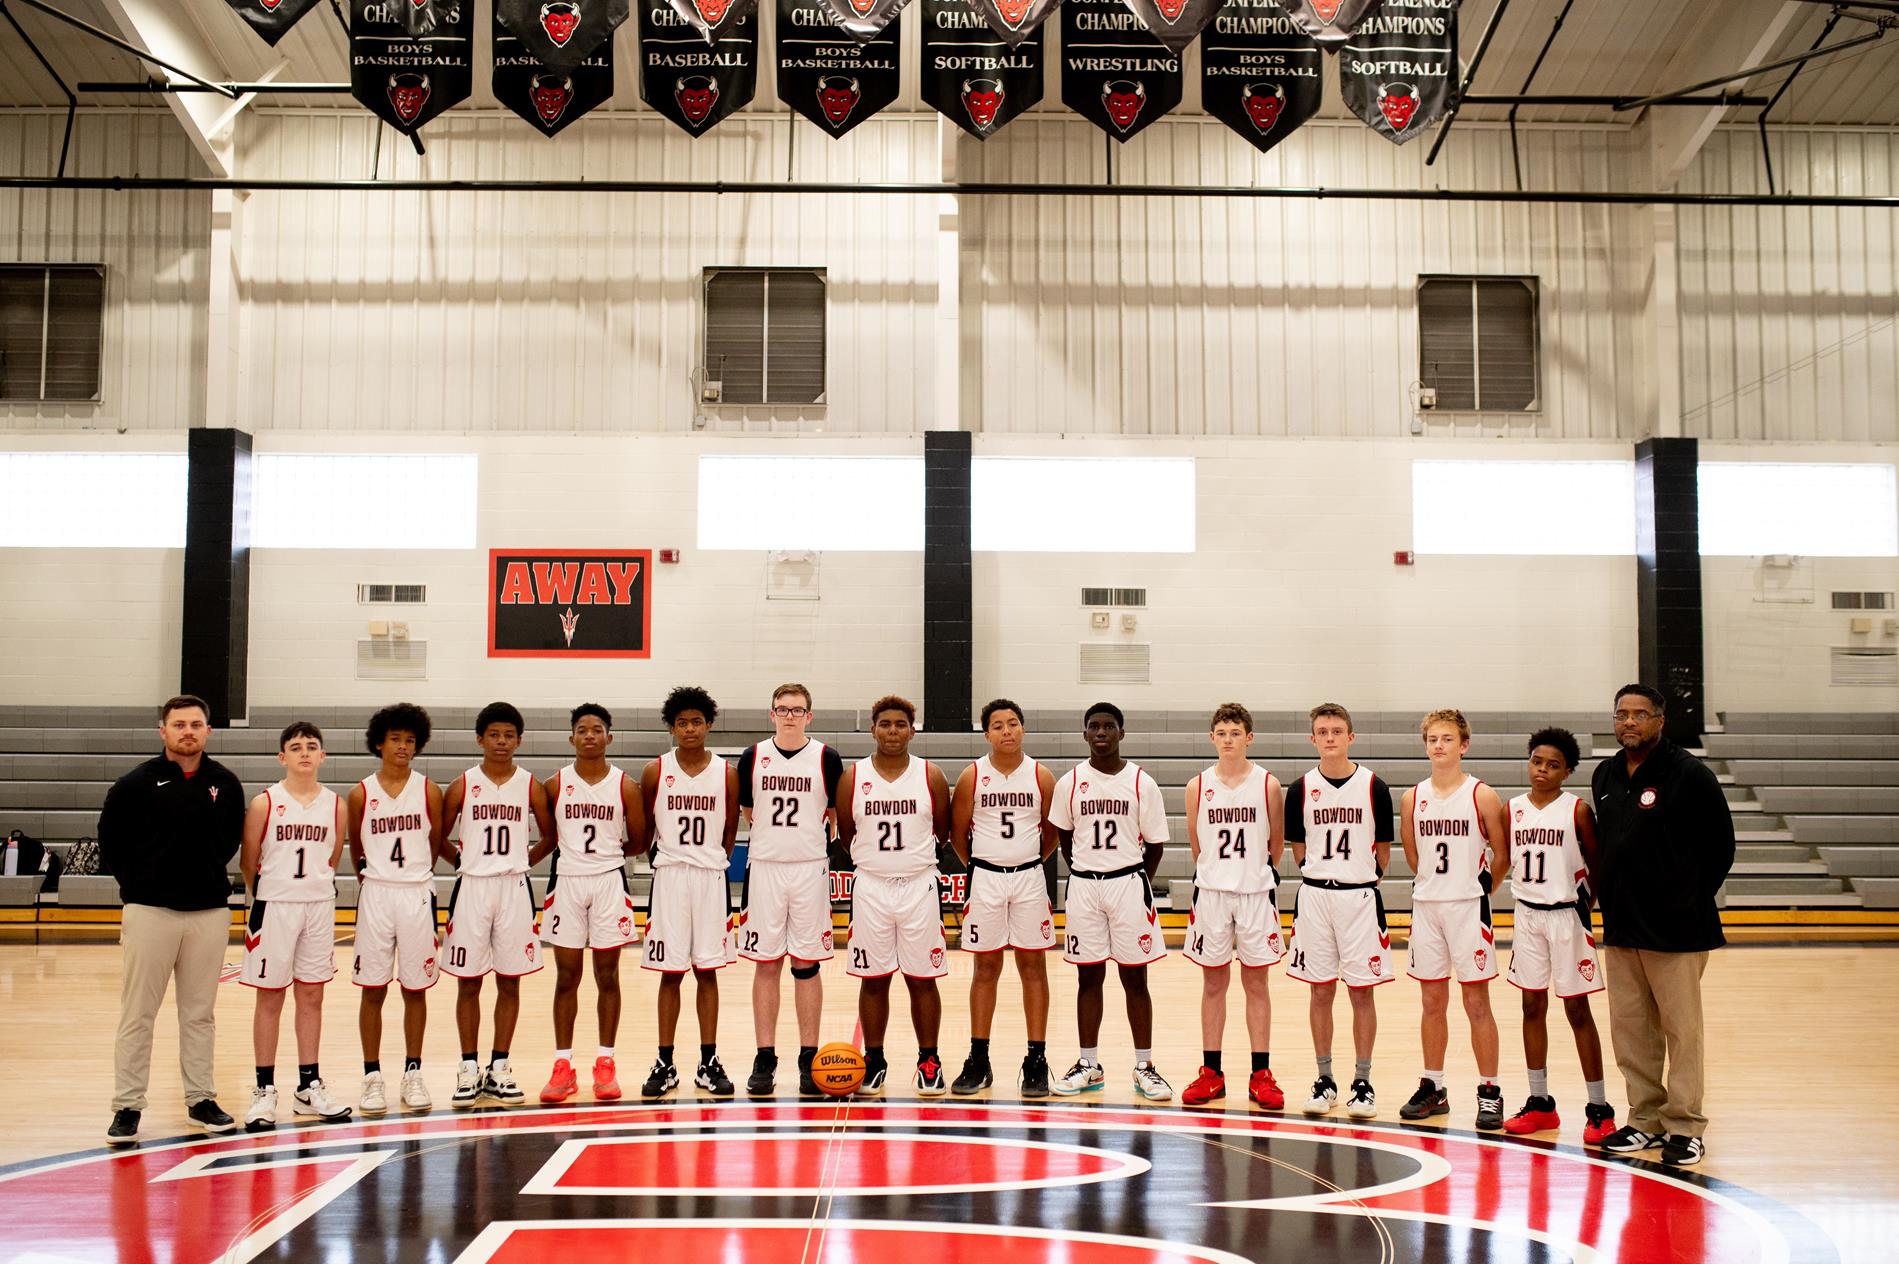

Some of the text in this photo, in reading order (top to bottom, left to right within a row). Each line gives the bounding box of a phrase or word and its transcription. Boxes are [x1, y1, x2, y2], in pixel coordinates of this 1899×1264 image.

[1076, 13, 1149, 31] CHAMPI
[1356, 16, 1445, 35] HAMPIONS
[388, 44, 433, 53] BOYS
[815, 48, 861, 57] BOYS
[354, 56, 467, 66] BASKETBALL
[496, 56, 608, 67] BASKLL
[649, 53, 749, 67] BASEBALL
[781, 59, 895, 70] BASKETBALL
[934, 56, 1034, 70] SOFTBALL
[1068, 58, 1178, 72] WRESTLING
[1239, 55, 1285, 65] BOYS
[1352, 60, 1448, 76] SOFTBALL
[1207, 66, 1318, 77] BASKETBALL
[501, 562, 640, 605] AWAY
[761, 776, 811, 793] BOWDON
[667, 795, 716, 812] BOWDON
[864, 800, 917, 816] BOWDON
[981, 792, 1034, 808] BOWDON
[1080, 799, 1129, 816] BOWDON
[472, 804, 522, 822] BOWDON
[565, 803, 614, 821] BOWDON
[771, 797, 799, 827] 22
[1208, 807, 1256, 824] BOWDON
[1313, 808, 1363, 825] BOWDON
[276, 824, 328, 843] BOWDON
[371, 814, 421, 834] BOWDON
[678, 816, 705, 846] 20
[1001, 811, 1014, 840] 5
[1419, 819, 1469, 837] BOWDON
[483, 825, 510, 855] 10
[583, 824, 596, 854] 2
[877, 821, 904, 851] 21
[1091, 820, 1118, 850] 12
[1218, 828, 1246, 859] 24
[1322, 829, 1351, 860] 14
[1515, 828, 1564, 847] BOWDON
[390, 837, 405, 868] 4
[1435, 842, 1448, 874] 3
[293, 847, 306, 879] 1
[1521, 850, 1546, 883] 11
[552, 915, 560, 935] 2
[970, 924, 979, 944] 5
[744, 930, 759, 952] 22
[1066, 934, 1080, 955] 12
[450, 945, 466, 968] 10
[649, 940, 665, 962] 20
[853, 947, 870, 970] 21
[1290, 948, 1305, 971] 14
[258, 958, 267, 978] 1
[354, 955, 361, 975] 4
[820, 1054, 857, 1066] Wilson
[826, 1074, 853, 1083] NCAA
